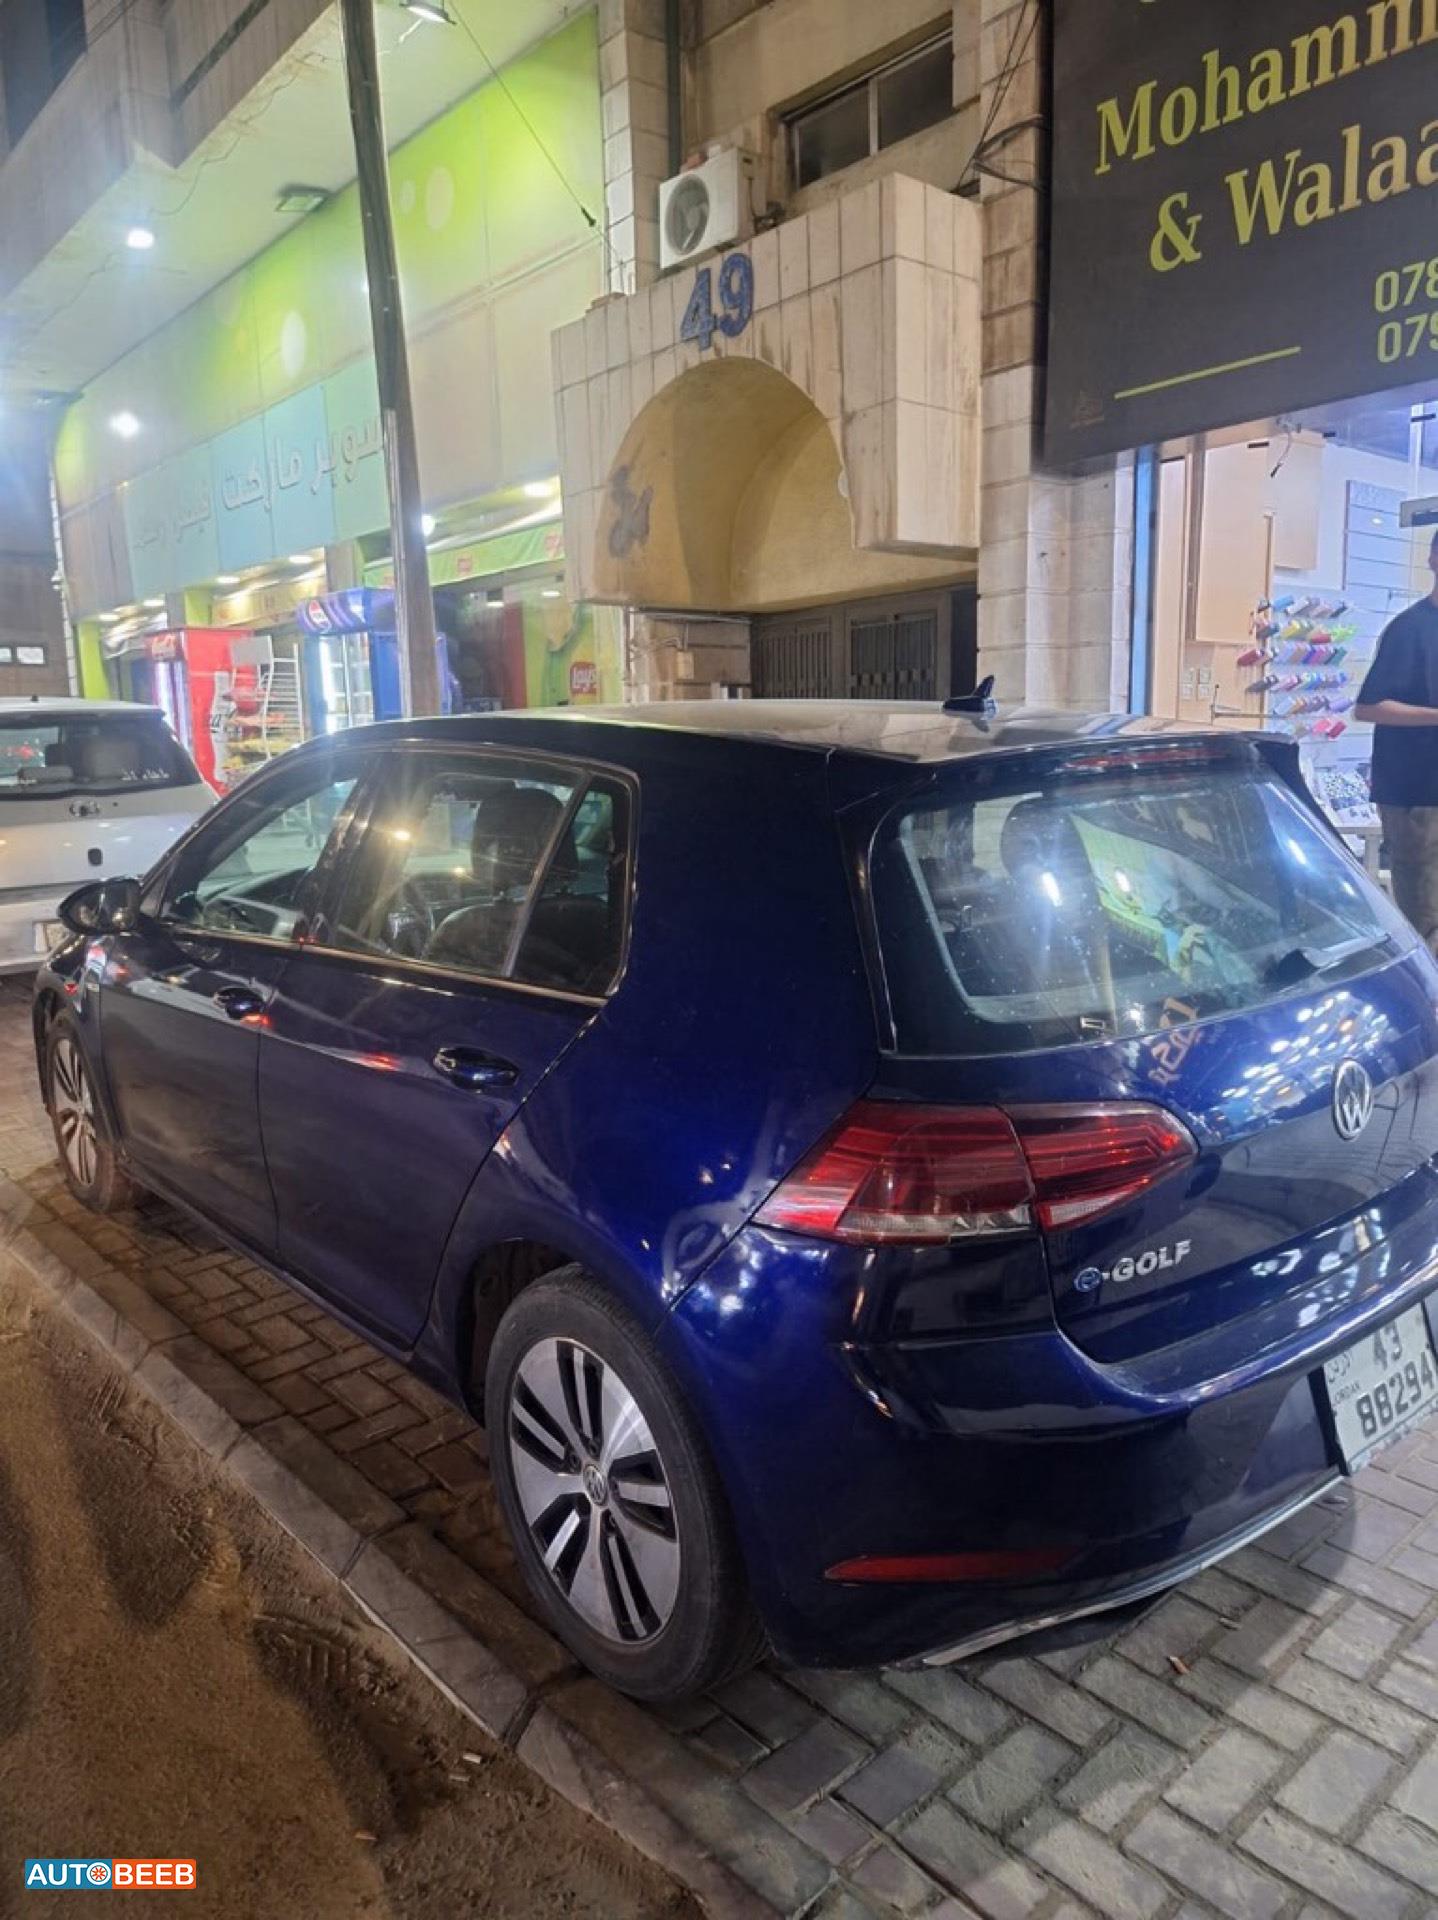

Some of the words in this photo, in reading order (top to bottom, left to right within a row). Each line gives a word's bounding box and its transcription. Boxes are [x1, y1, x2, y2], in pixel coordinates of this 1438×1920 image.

[1150, 192, 1202, 272] &
[680, 252, 754, 352] 49
[1355, 1350, 1436, 1439] 88294
